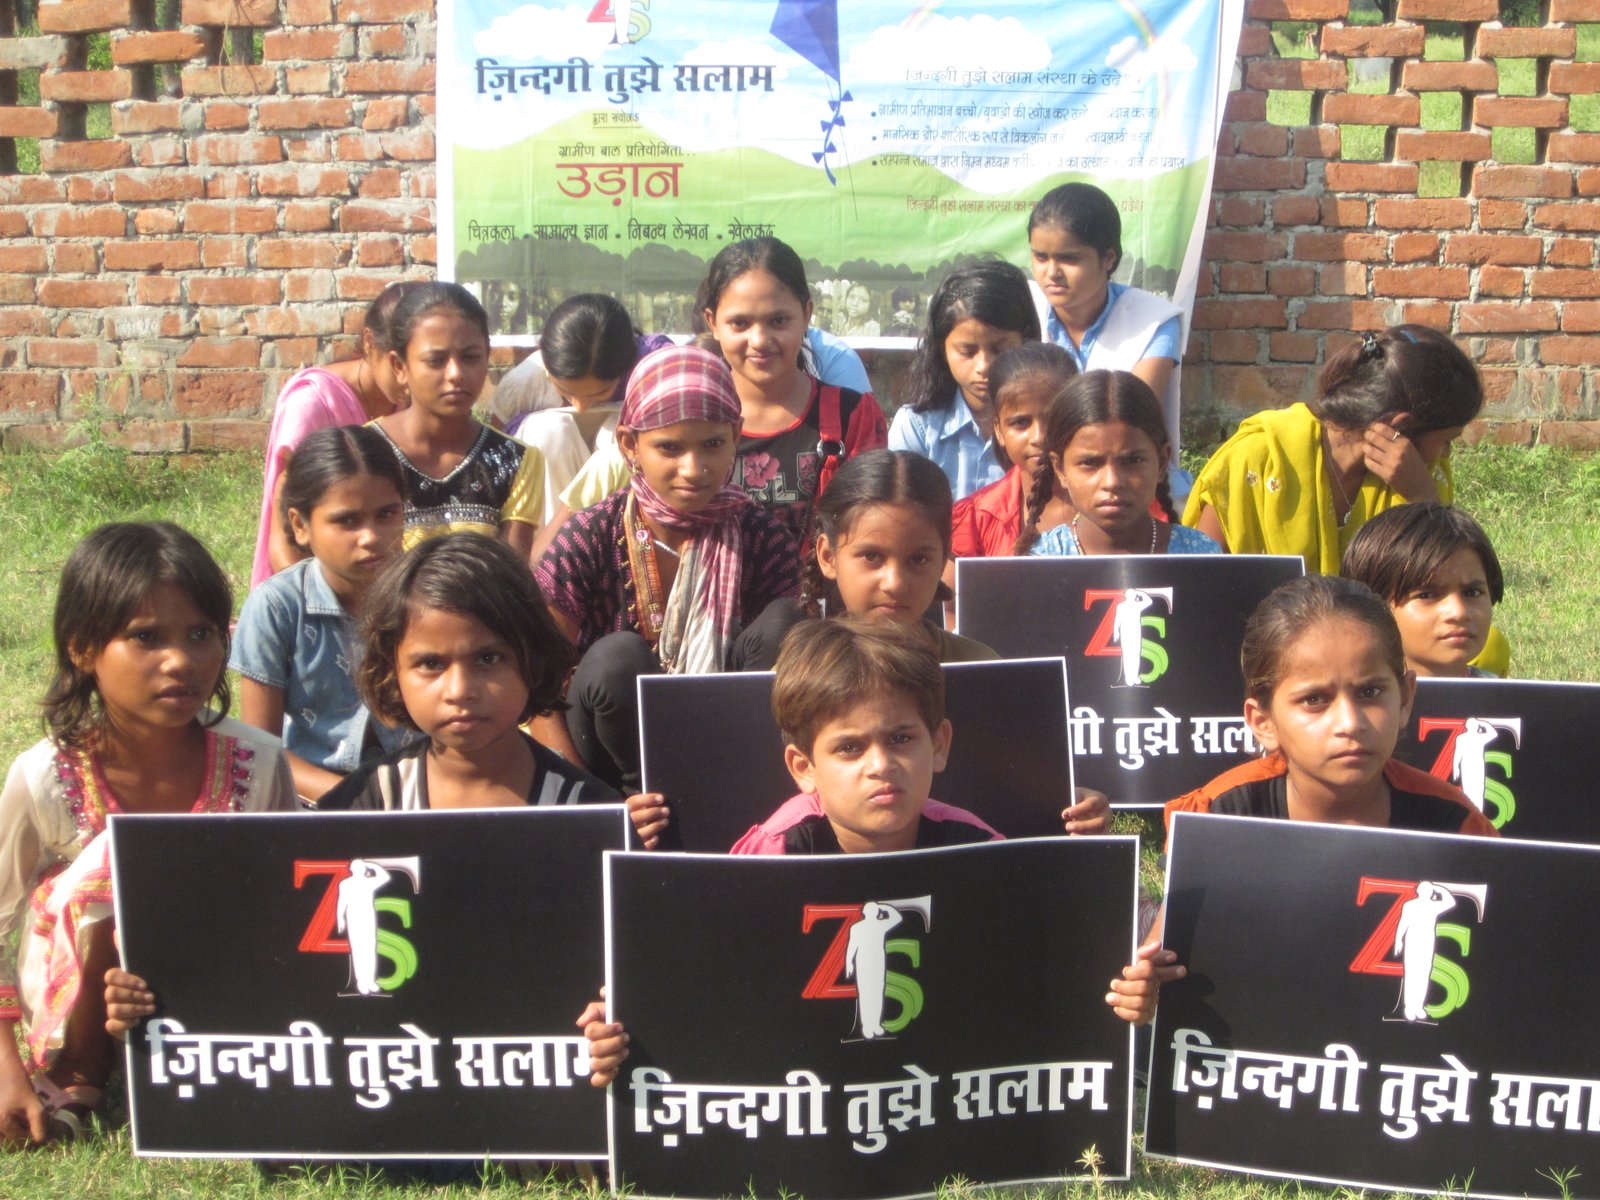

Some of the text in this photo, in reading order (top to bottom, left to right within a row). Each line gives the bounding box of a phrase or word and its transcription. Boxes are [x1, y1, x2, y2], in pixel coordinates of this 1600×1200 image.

[475, 56, 776, 104] ज़िन्दगी तुझे सलाम
[962, 66, 987, 88] तुझे
[992, 70, 1034, 84] सलाम
[1037, 67, 1077, 85] संस्था
[1081, 68, 1098, 85] के
[879, 99, 908, 118] ग्रामीण
[910, 99, 952, 118] प्रतिभावान
[1013, 102, 1026, 119] की
[1029, 102, 1050, 120] खोज
[1053, 108, 1068, 121] कर
[881, 125, 919, 141] मानसिक
[922, 125, 938, 142] और
[940, 126, 980, 144] शारीरिक
[982, 131, 998, 144] रूप
[1000, 127, 1009, 144] से
[558, 141, 595, 158] ग्रामीण
[600, 145, 621, 158] बाल
[879, 154, 909, 168] सम्पन्न
[912, 154, 938, 168] समाज
[961, 151, 982, 168] निम्न
[984, 155, 1010, 168] मध्यम
[1066, 157, 1079, 168] का
[556, 162, 684, 206] उड़ान
[959, 200, 984, 212] सलाम
[1014, 200, 1026, 213] का
[468, 219, 515, 241] चित्रकला
[533, 223, 578, 241] सामान्य
[583, 223, 608, 241] ज्ञान
[627, 217, 667, 241] निबन्ध
[672, 216, 709, 241] लेखन
[1113, 707, 1181, 770] तुझे
[145, 1018, 333, 1098] ज़िन्दगी
[344, 1023, 440, 1109] तुझे
[1170, 1028, 1367, 1111] ज़िन्दगी
[1379, 1054, 1477, 1140] तुझे
[629, 1061, 1113, 1154] ज़िन्दगी तुझे सलाम
